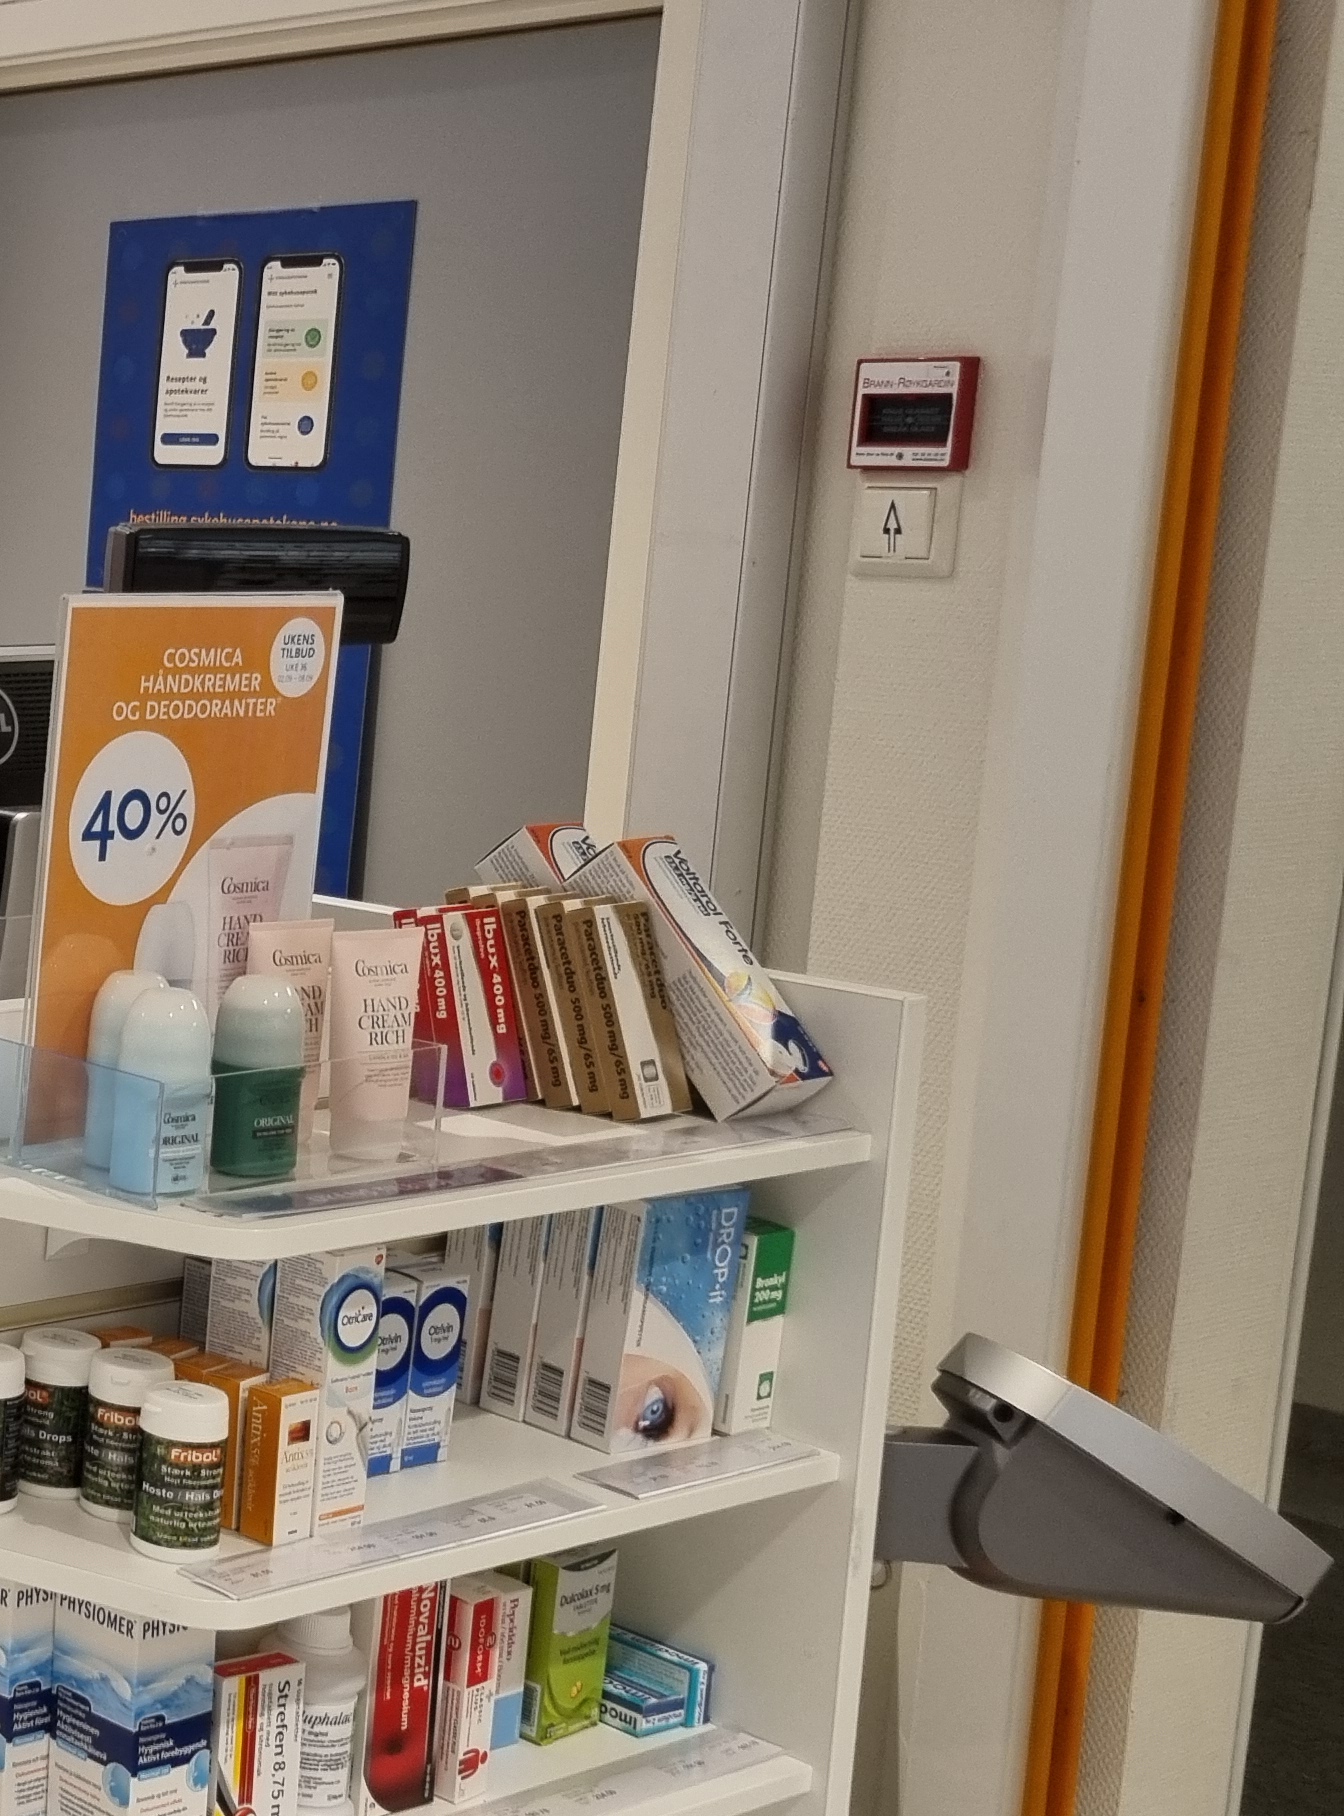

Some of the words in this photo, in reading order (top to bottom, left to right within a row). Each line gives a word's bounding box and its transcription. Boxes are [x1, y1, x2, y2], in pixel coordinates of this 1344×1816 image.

[166, 374, 196, 385] Resepter
[198, 375, 207, 385] og
[283, 634, 315, 645] UKENS
[163, 648, 243, 668] COSMICA
[281, 647, 315, 658] TILBUD
[139, 669, 262, 694] HÅNDKREMER
[113, 702, 141, 723] OG
[145, 697, 277, 720] DEODORANTER
[80, 787, 188, 863] 40%
[221, 876, 270, 894] Cosmica
[672, 848, 723, 916] Voltarol
[718, 919, 754, 968] Forte
[222, 914, 263, 931] HAND
[426, 923, 443, 968] Ibux
[483, 915, 497, 969] Ibux
[516, 910, 540, 990] Paracetduo
[272, 949, 322, 966] Cosmica
[551, 914, 577, 994] Paracetduo
[354, 959, 409, 976] Cosmica
[431, 969, 447, 998] 400
[491, 972, 505, 1004] 400
[362, 996, 409, 1012] HAND
[435, 999, 448, 1020] mg
[358, 1012, 412, 1030] CREAM
[495, 1010, 506, 1035] mg
[368, 1030, 407, 1047] RICH
[162, 1112, 197, 1126] Cosmica
[254, 1115, 294, 1128] ORIGINAL
[707, 1206, 738, 1305] DROP-it
[755, 1271, 786, 1290] Bronkyl
[340, 1306, 374, 1328] OtriCare
[427, 1321, 455, 1337] Otrivin
[39, 1430, 72, 1445] Drops
[171, 1448, 218, 1462] Fribol
[559, 1591, 593, 1608] Dulcolax
[601, 1582, 612, 1596] mg
[59, 1593, 135, 1639] PHYSIOMER
[413, 1583, 438, 1688] Novaluzid
[475, 1614, 487, 1670] IDOFORM
[274, 1679, 290, 1757] Strefen
[302, 1711, 352, 1729] uphalac
